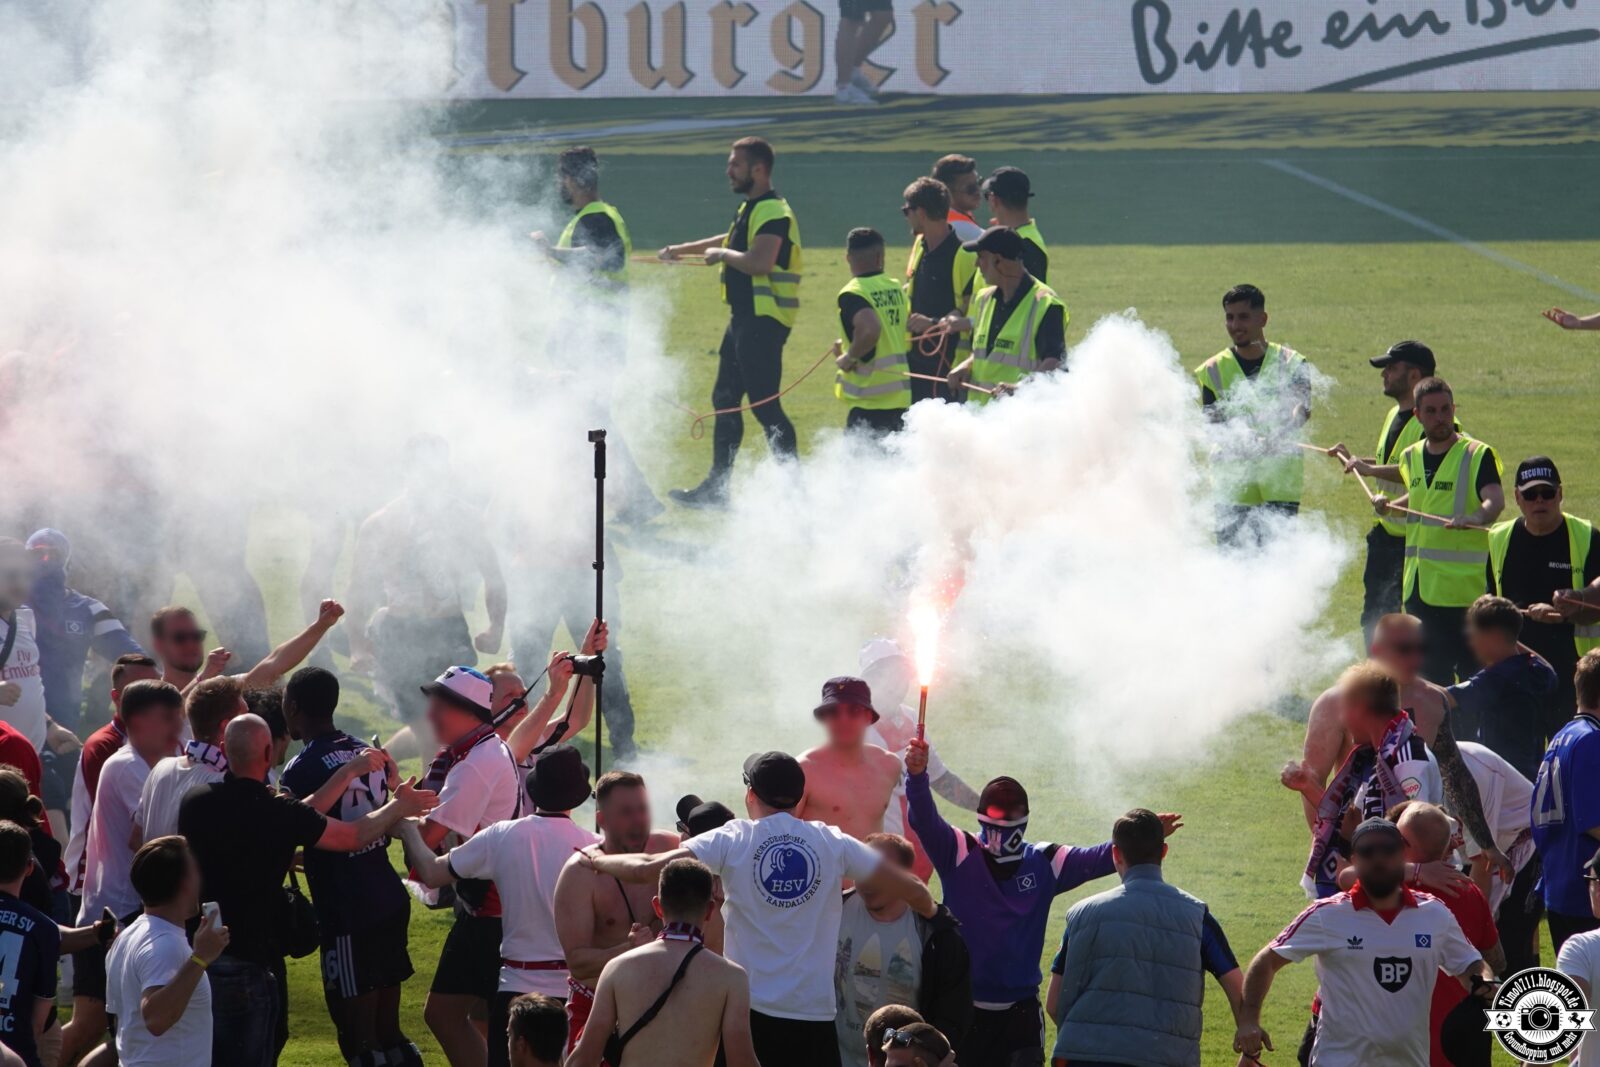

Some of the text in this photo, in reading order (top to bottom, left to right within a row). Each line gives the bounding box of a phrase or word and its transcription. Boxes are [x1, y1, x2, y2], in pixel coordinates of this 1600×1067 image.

[1131, 0, 1302, 85] Bitte
[1321, 0, 1451, 50] ein
[870, 288, 904, 308] SECURITY
[1520, 467, 1552, 480] SECURITY
[766, 879, 821, 908] RANDALIERER
[771, 879, 805, 892] HSV
[18, 916, 36, 932] SV
[1380, 963, 1409, 983] BP
